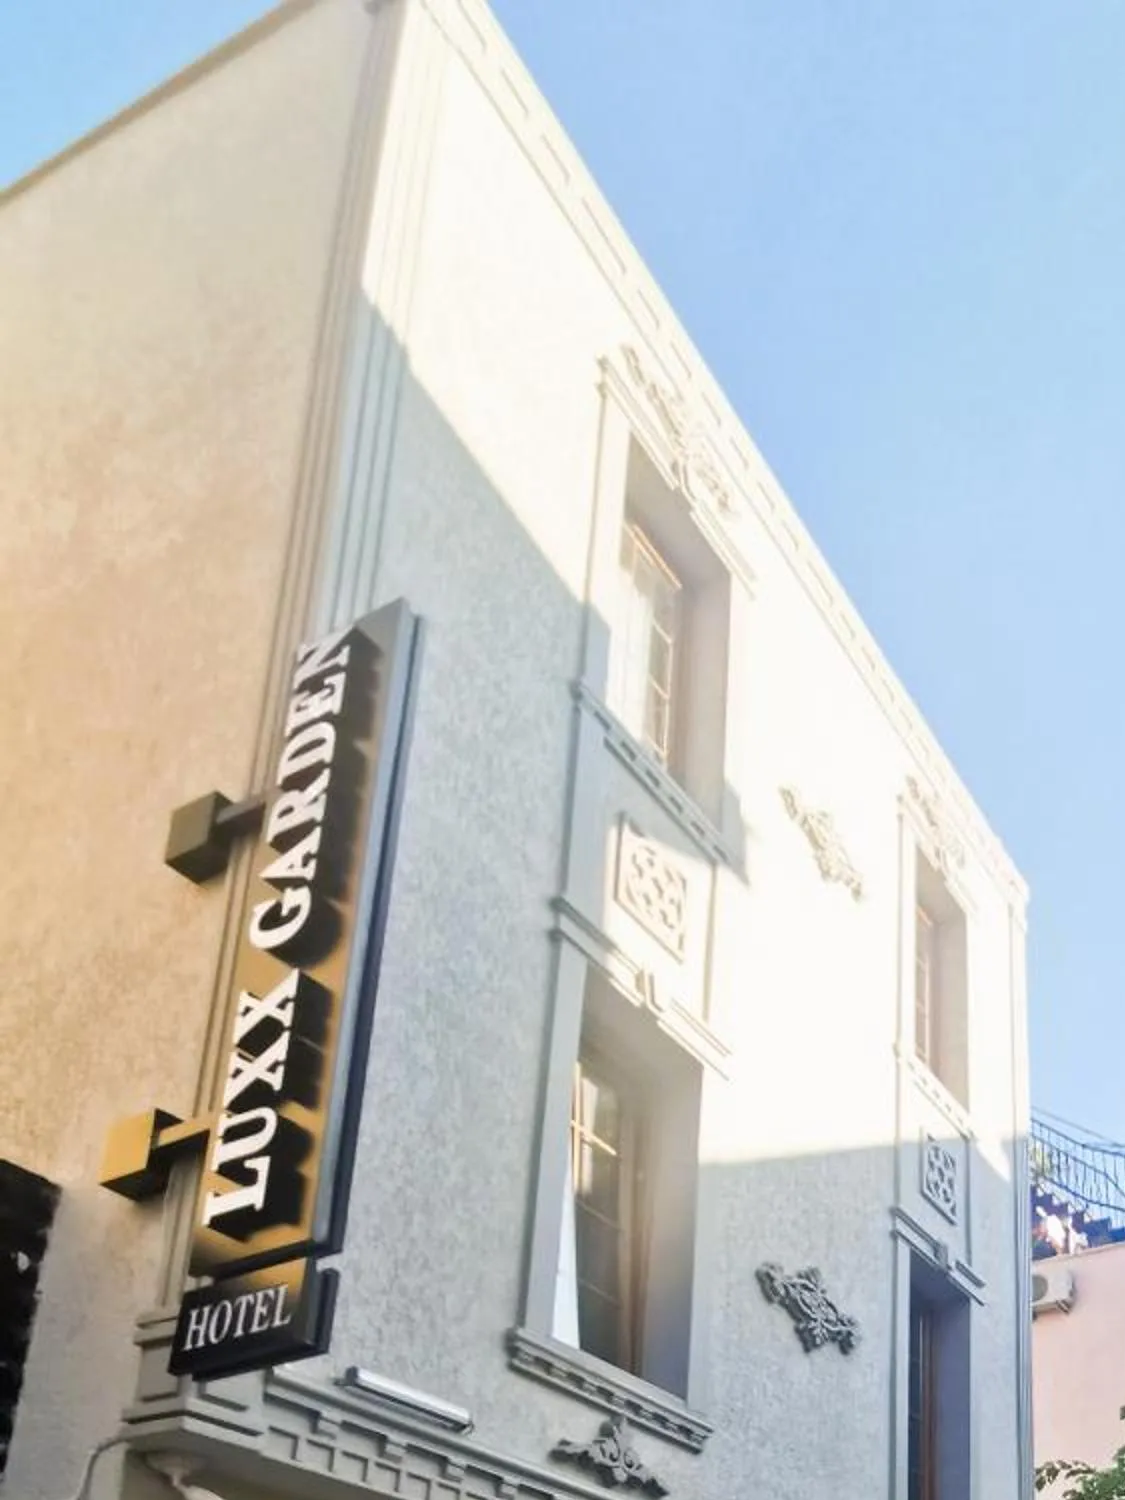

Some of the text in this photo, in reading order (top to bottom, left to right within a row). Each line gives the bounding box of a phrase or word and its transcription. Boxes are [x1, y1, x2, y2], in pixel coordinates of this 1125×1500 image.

[202, 625, 353, 1227] LUXX GARDEN
[183, 1284, 291, 1351] HOTEL
